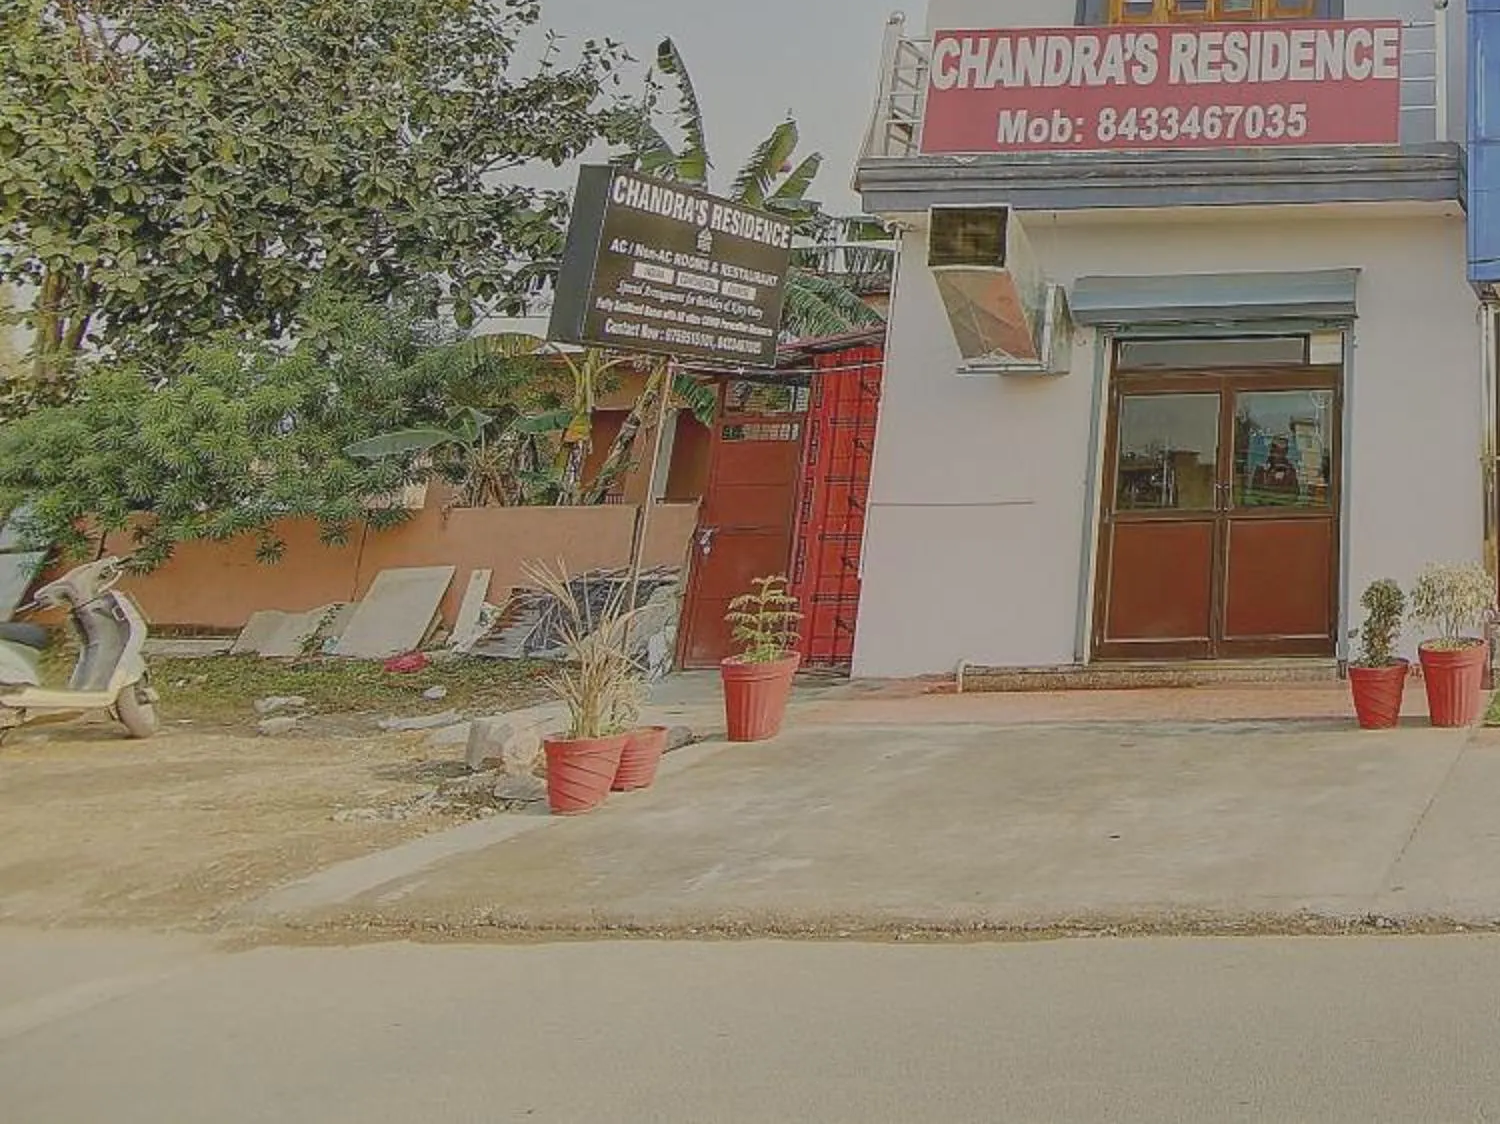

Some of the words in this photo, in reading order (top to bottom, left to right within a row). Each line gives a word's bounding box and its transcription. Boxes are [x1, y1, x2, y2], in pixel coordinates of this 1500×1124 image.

[931, 32, 1159, 90] CHANDRA'S
[1168, 27, 1400, 84] RESIDENCE
[997, 108, 1084, 144] Mob:
[1097, 103, 1307, 142] 8433467035
[613, 175, 709, 226] CHANDRA'S
[710, 203, 791, 249] RESIDENCE
[609, 238, 629, 254] AC
